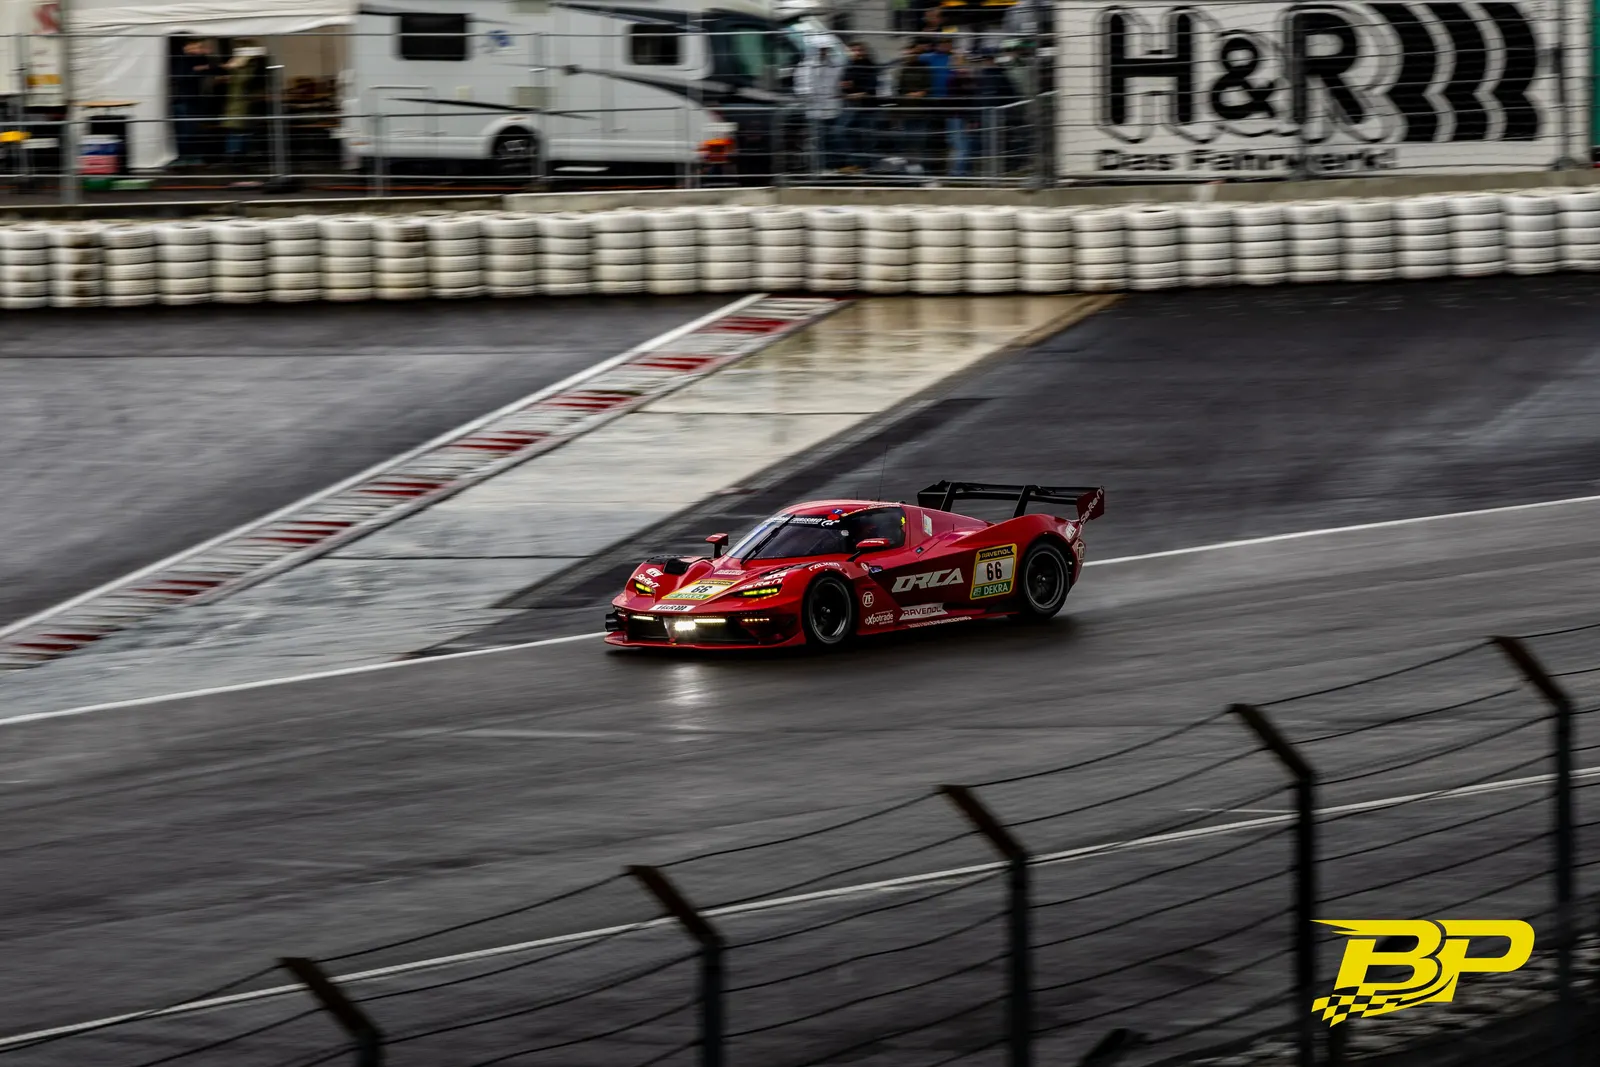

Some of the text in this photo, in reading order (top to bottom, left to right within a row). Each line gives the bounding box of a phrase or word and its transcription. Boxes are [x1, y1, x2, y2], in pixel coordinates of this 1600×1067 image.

[1102, 6, 1370, 138] H&R
[1098, 149, 1175, 171] Das
[981, 547, 1012, 559] RAVENOL
[986, 561, 1003, 581] 66
[891, 567, 964, 593] ORCA
[690, 585, 713, 594] 66
[983, 582, 1009, 596] DEKRA
[903, 606, 942, 617] RAVENOL
